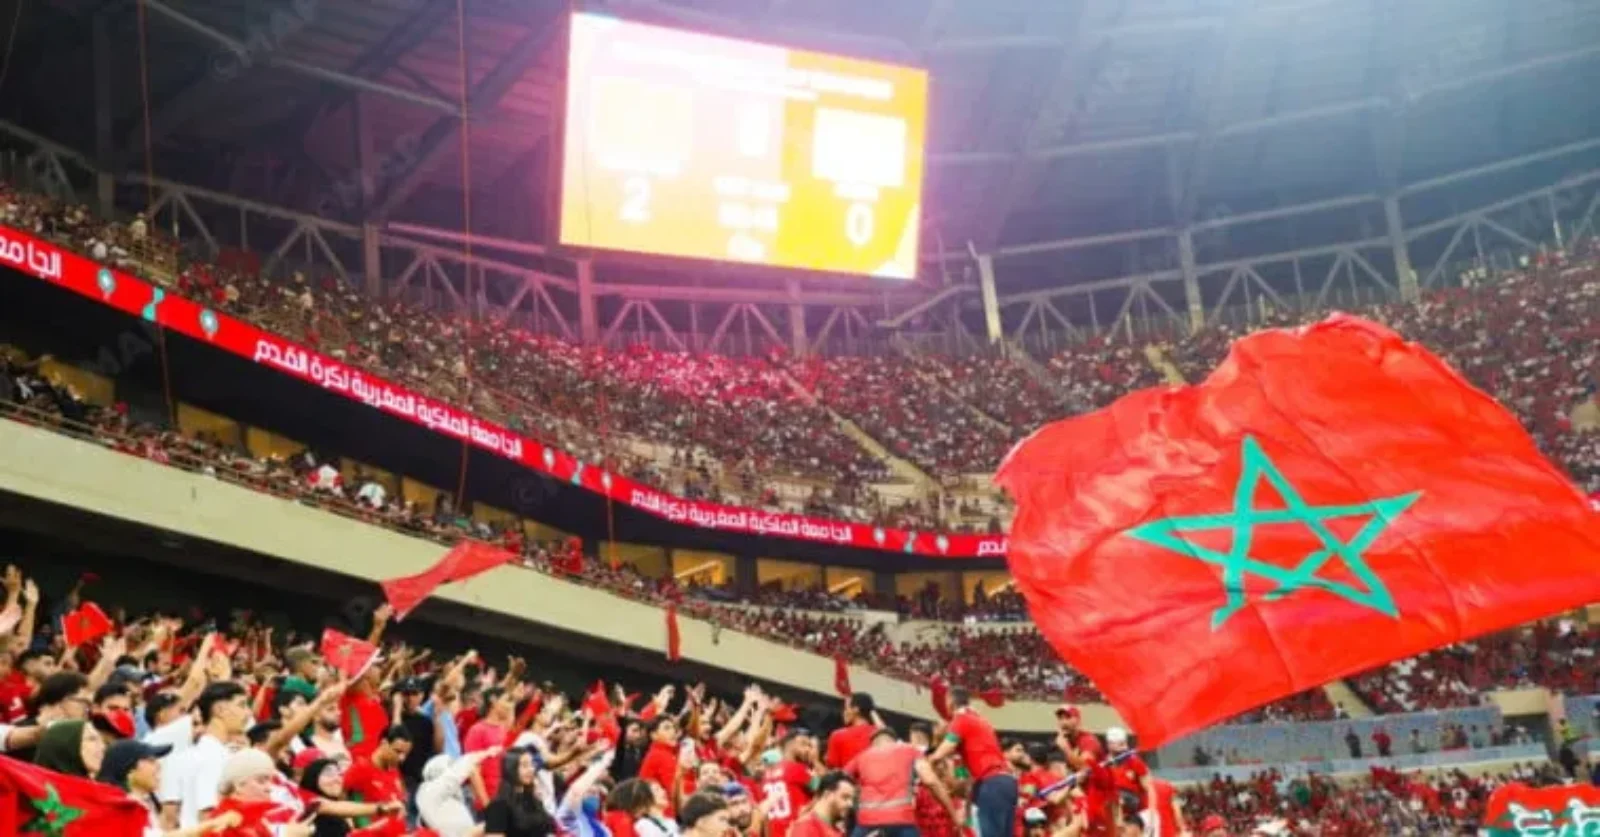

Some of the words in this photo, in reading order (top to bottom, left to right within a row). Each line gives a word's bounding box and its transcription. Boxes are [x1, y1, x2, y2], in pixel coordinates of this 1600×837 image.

[620, 178, 650, 224] 2
[846, 203, 873, 246] 0
[254, 339, 308, 374] القدم
[312, 355, 349, 389] لكرة
[351, 371, 415, 417] المغربية
[417, 397, 470, 439] الملكية
[470, 418, 522, 458] الجامعة
[689, 503, 746, 528] المغربية
[748, 511, 799, 534] الملكية
